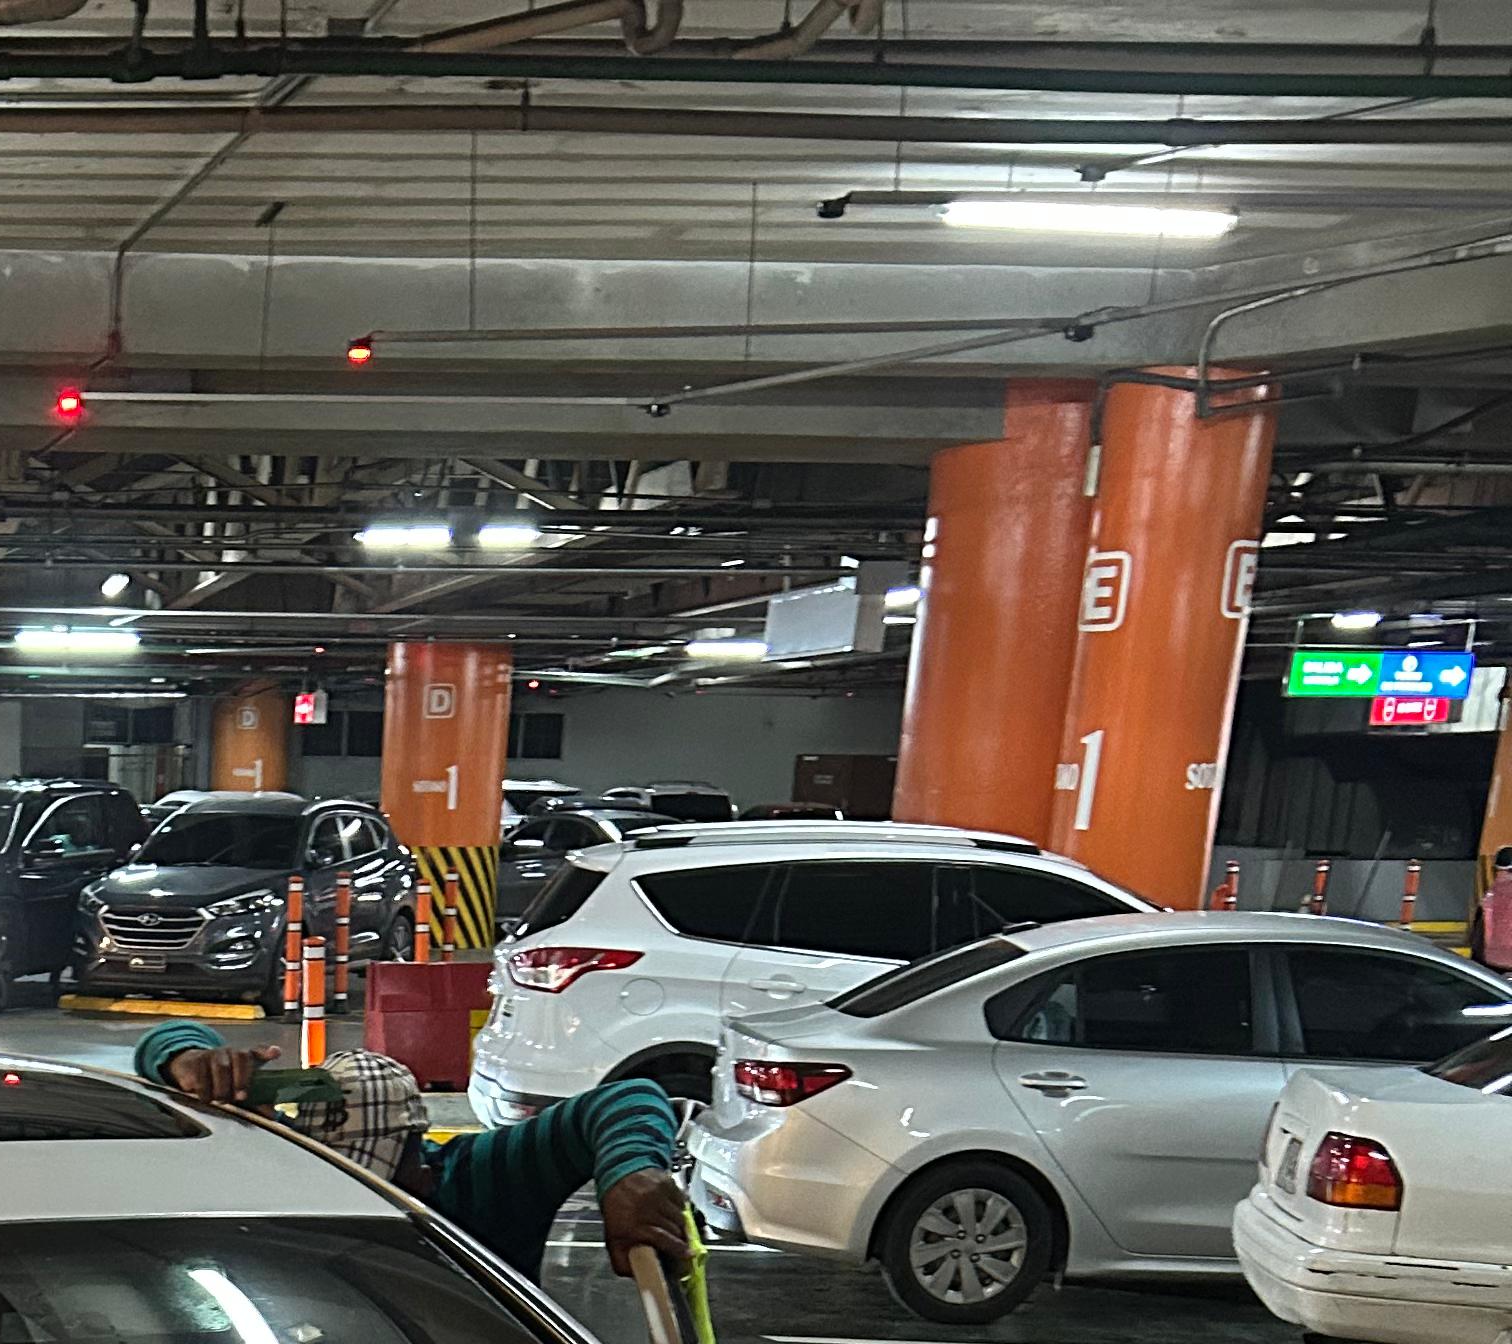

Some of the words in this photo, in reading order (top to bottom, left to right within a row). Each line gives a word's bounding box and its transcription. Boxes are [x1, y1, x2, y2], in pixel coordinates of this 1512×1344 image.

[1084, 565, 1118, 620] E
[242, 710, 254, 726] D
[429, 689, 450, 713] D
[446, 765, 458, 810] 1
[1074, 730, 1104, 830] 1
